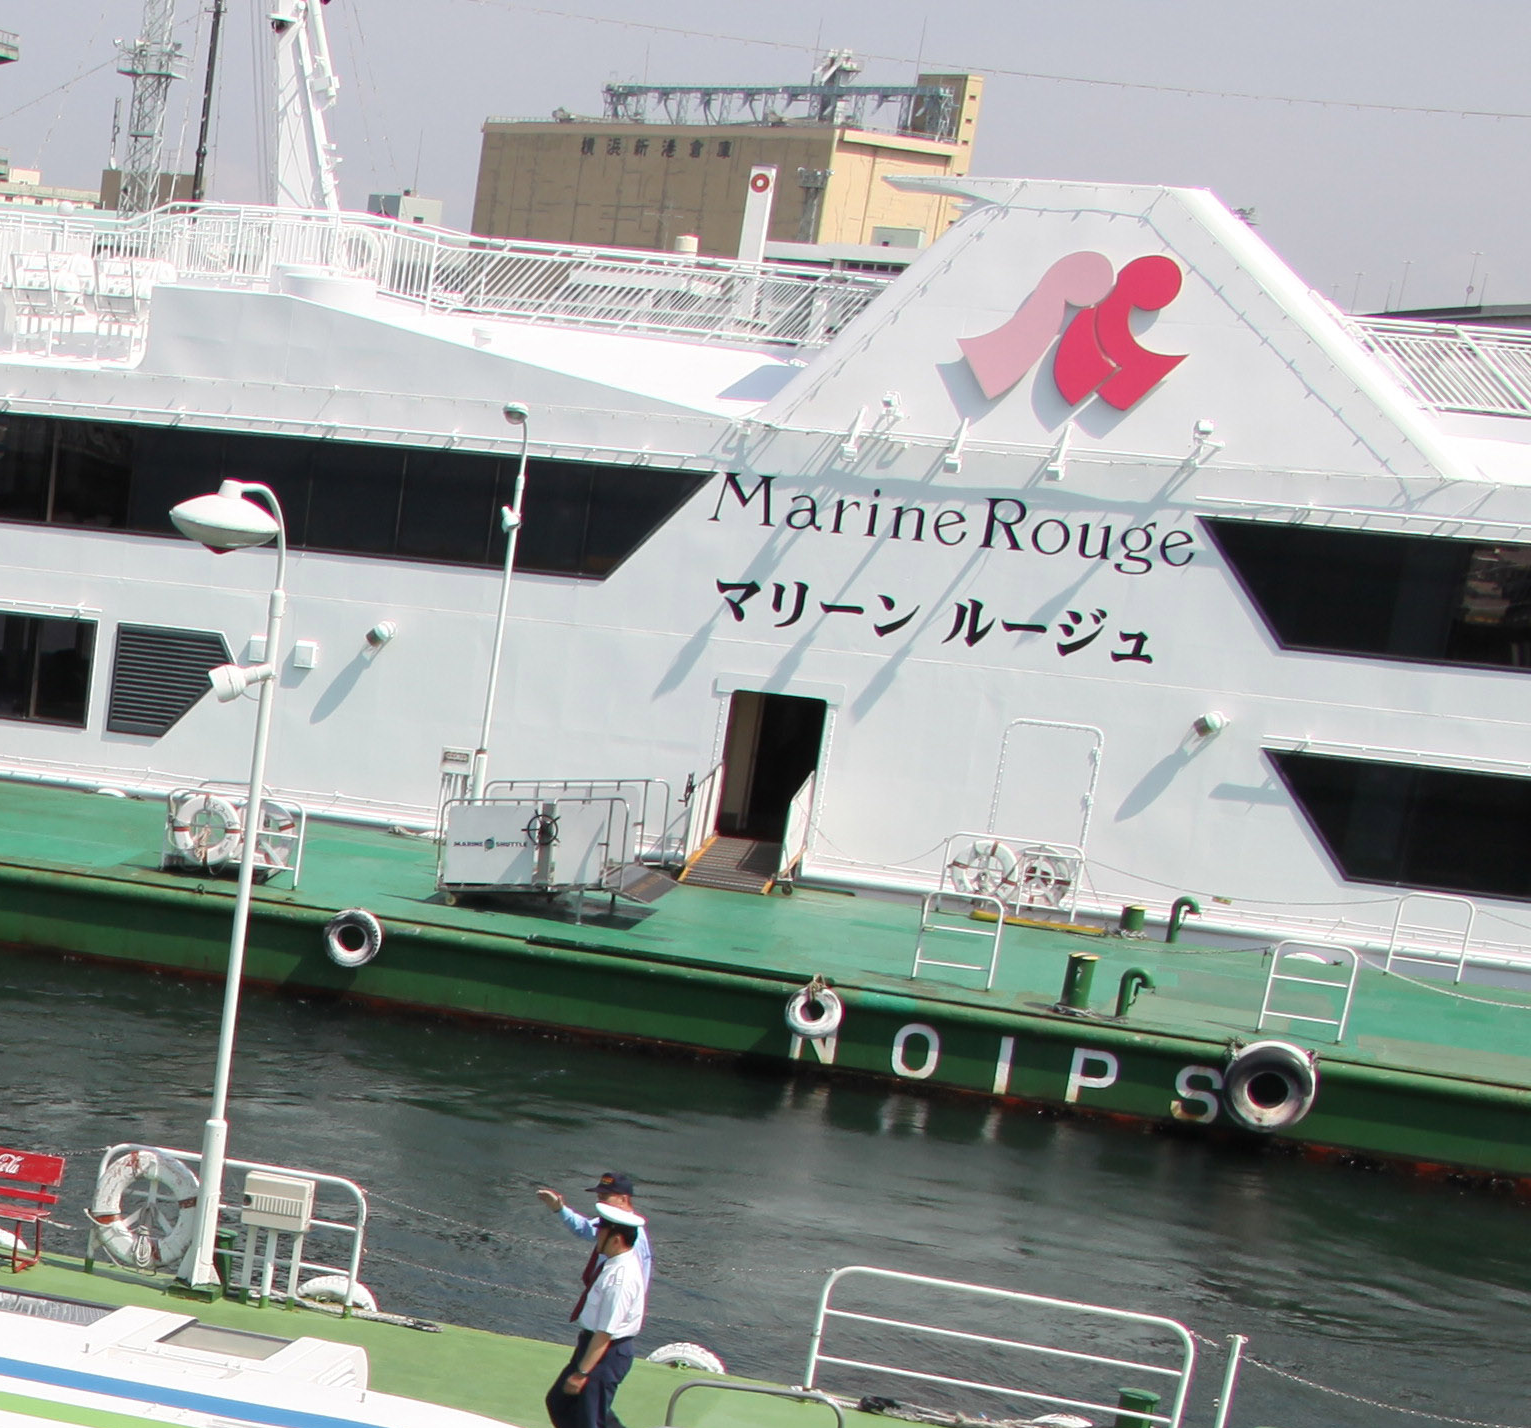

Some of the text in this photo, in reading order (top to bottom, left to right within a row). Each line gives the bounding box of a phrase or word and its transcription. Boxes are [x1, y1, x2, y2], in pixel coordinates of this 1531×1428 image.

[707, 472, 1196, 575] Marine Rouge
[715, 578, 1154, 664] マリーン ルージュ
